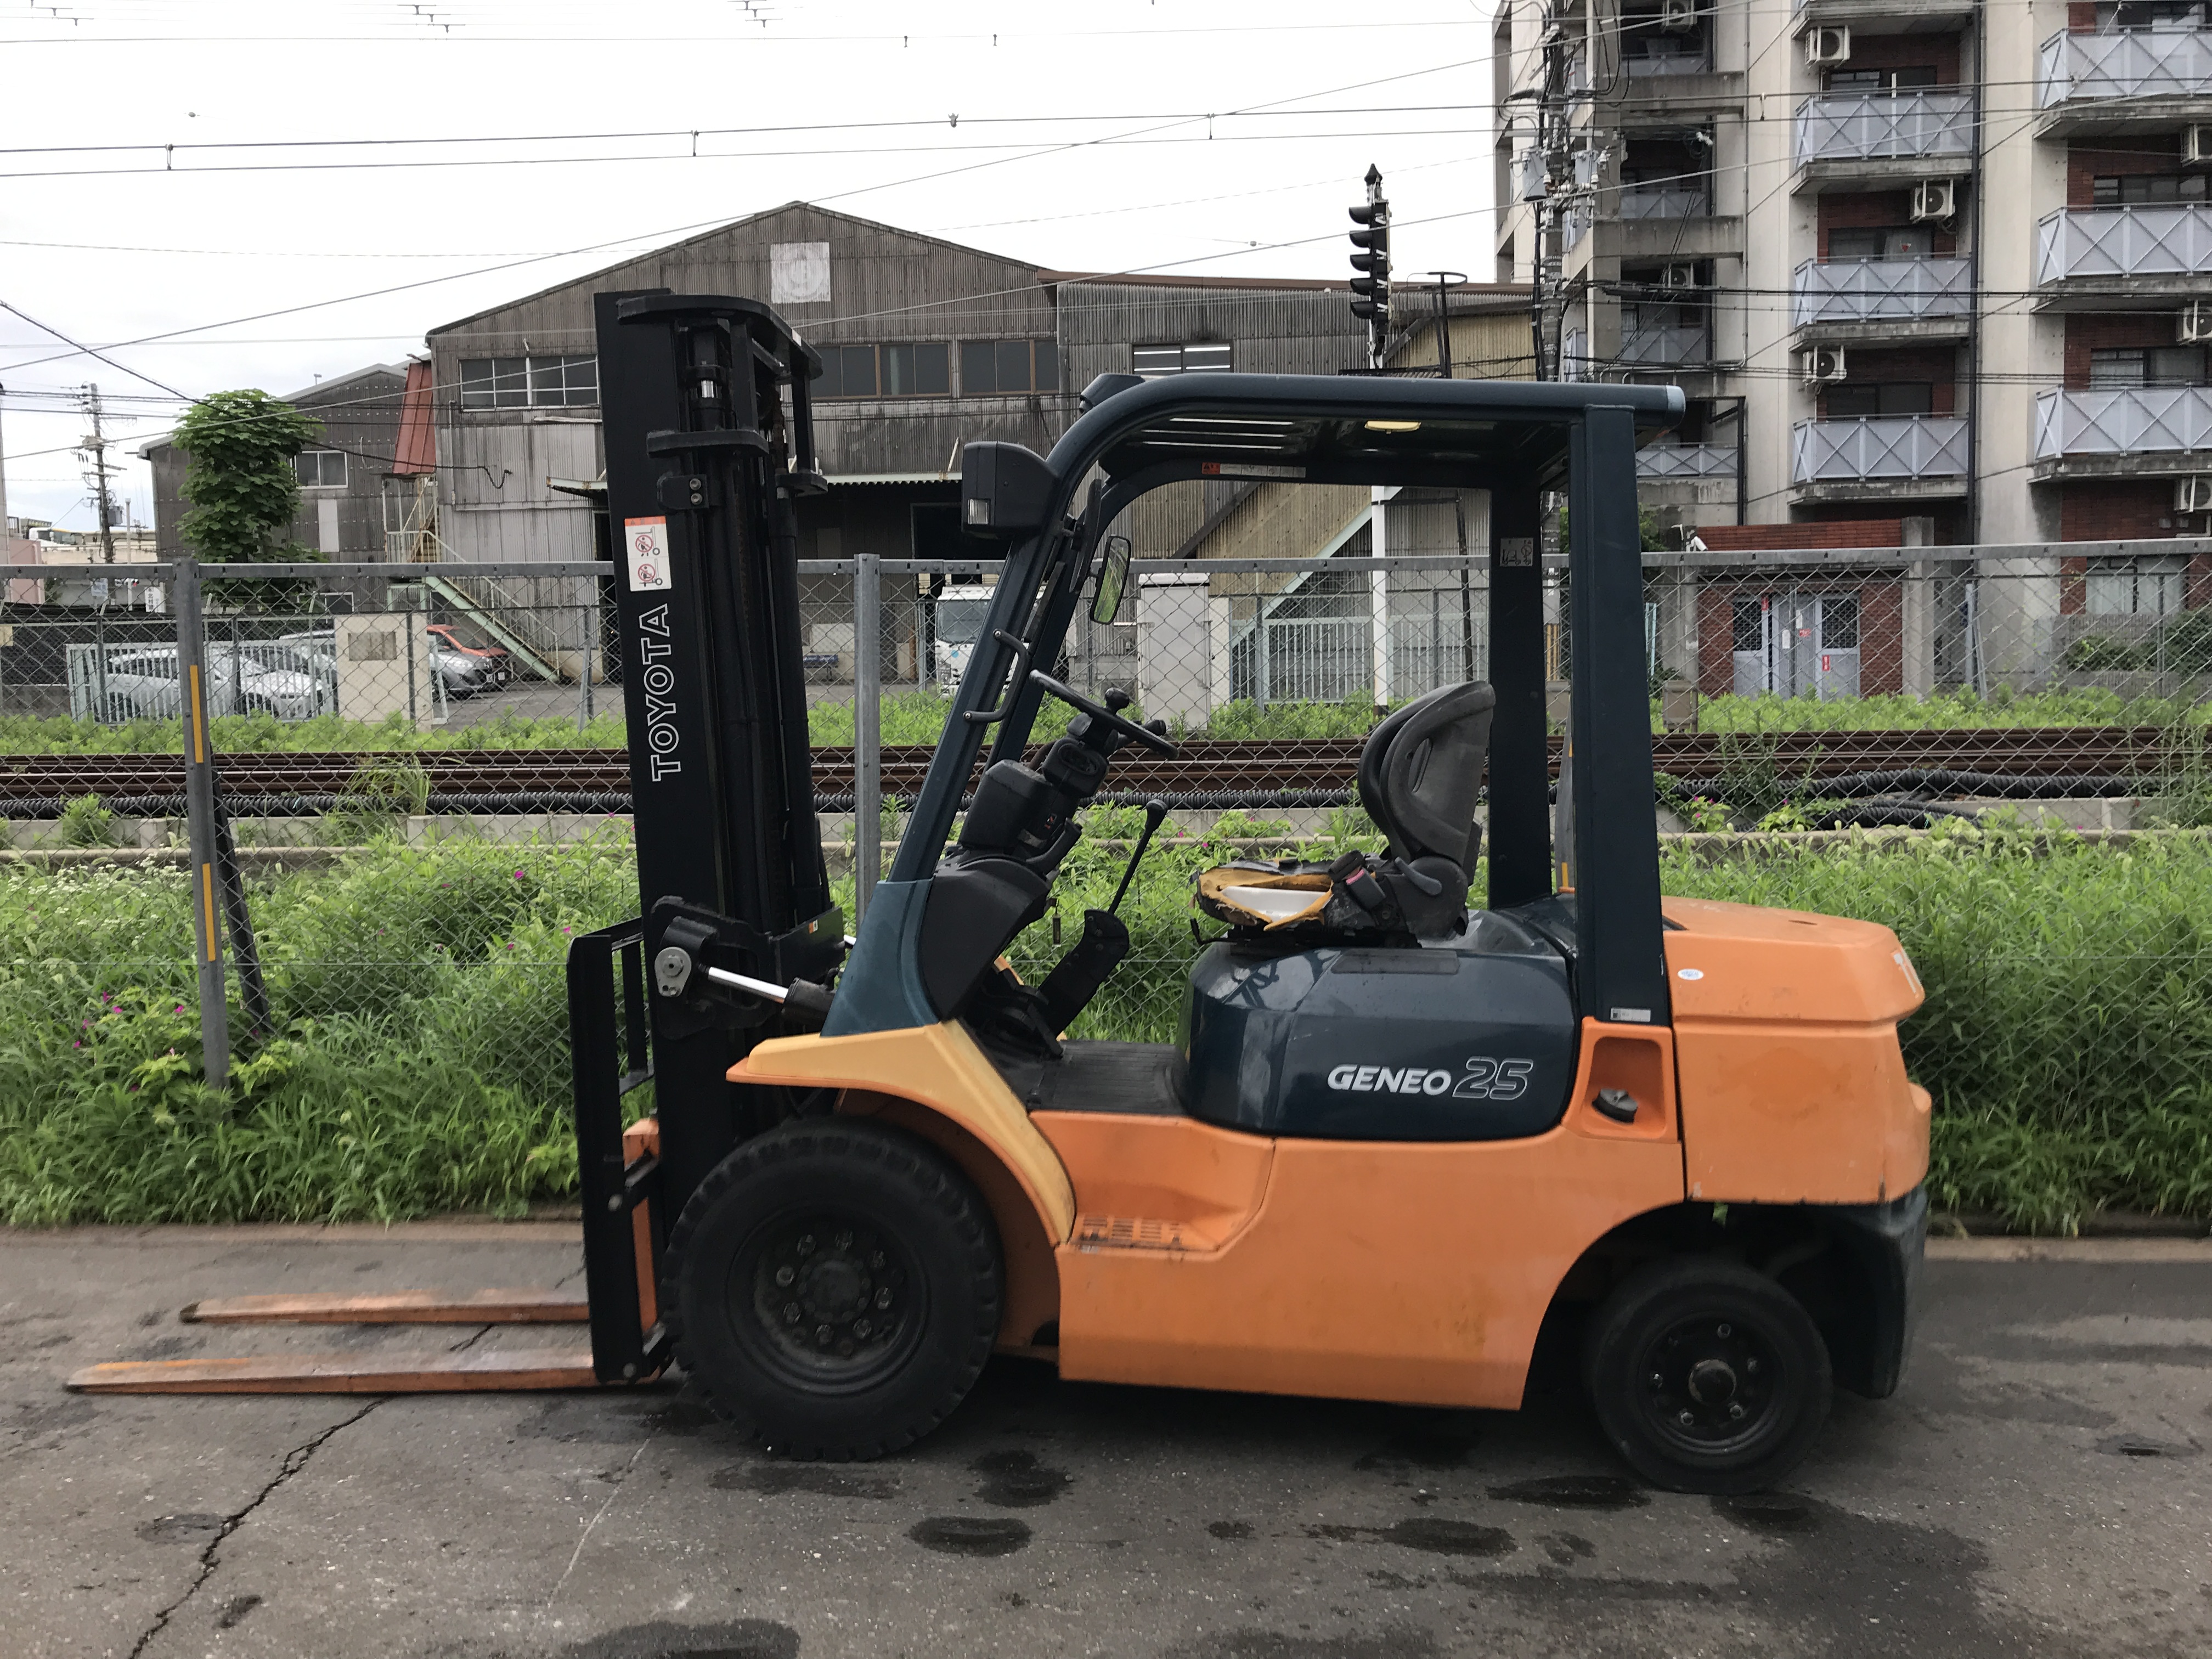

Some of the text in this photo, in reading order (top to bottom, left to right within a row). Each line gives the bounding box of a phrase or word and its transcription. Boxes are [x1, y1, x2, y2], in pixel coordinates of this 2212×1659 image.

[639, 603, 681, 782] TOYOTA
[1327, 1056, 1533, 1101] GENEO 25
